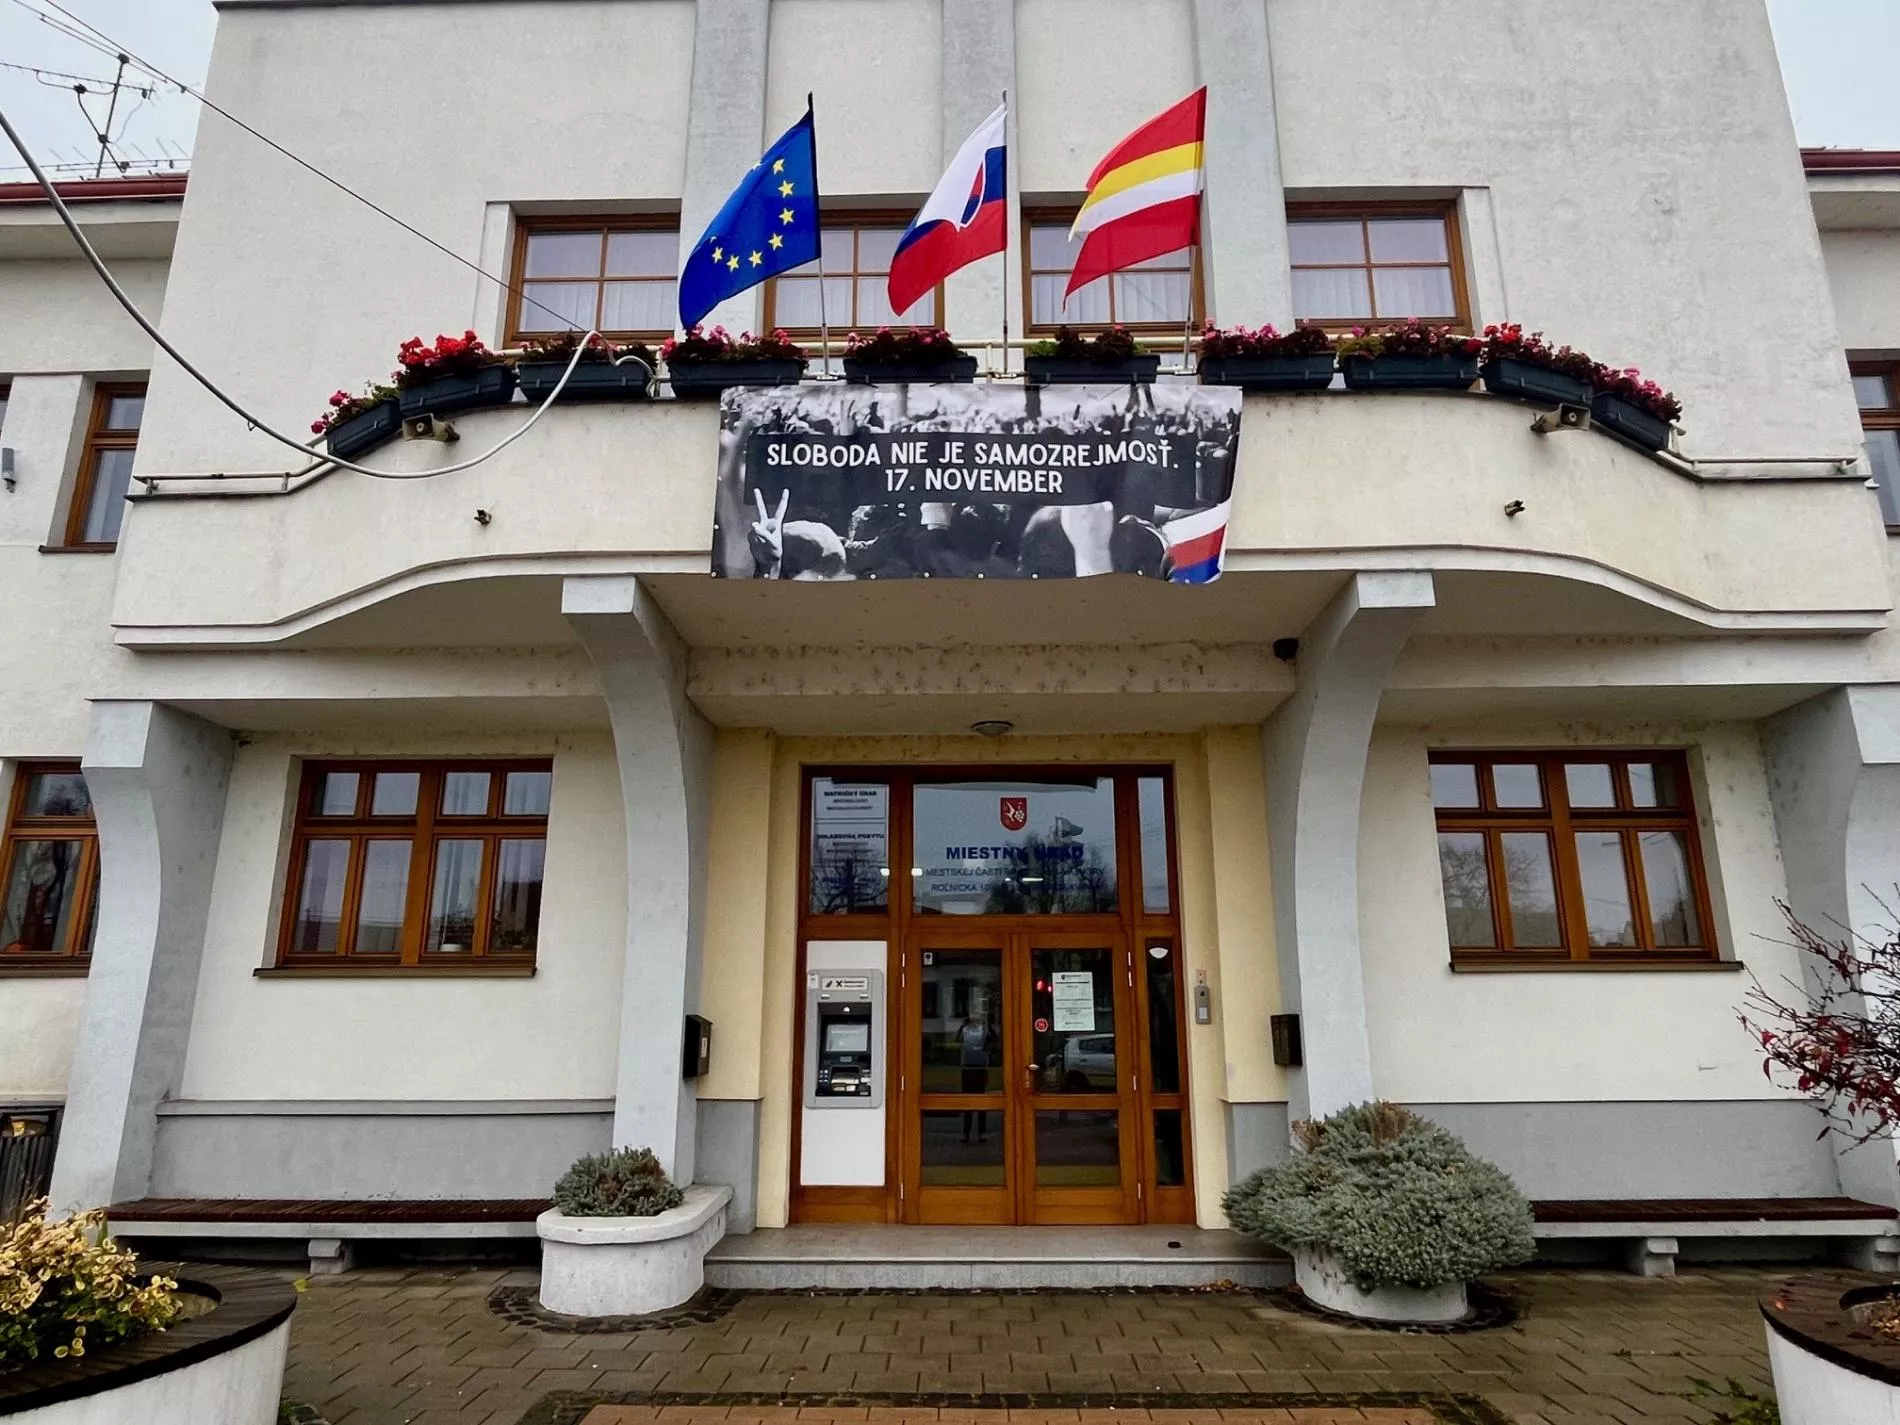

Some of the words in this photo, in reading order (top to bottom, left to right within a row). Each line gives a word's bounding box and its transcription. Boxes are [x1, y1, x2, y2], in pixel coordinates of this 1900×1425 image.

[767, 442, 881, 468] SLOBODA
[891, 441, 929, 465] NIE
[938, 441, 965, 464] JE
[974, 439, 1179, 468] SAMOZREJMOSŤ.
[885, 468, 915, 492] 17.
[925, 467, 1063, 493] NOVEMBER
